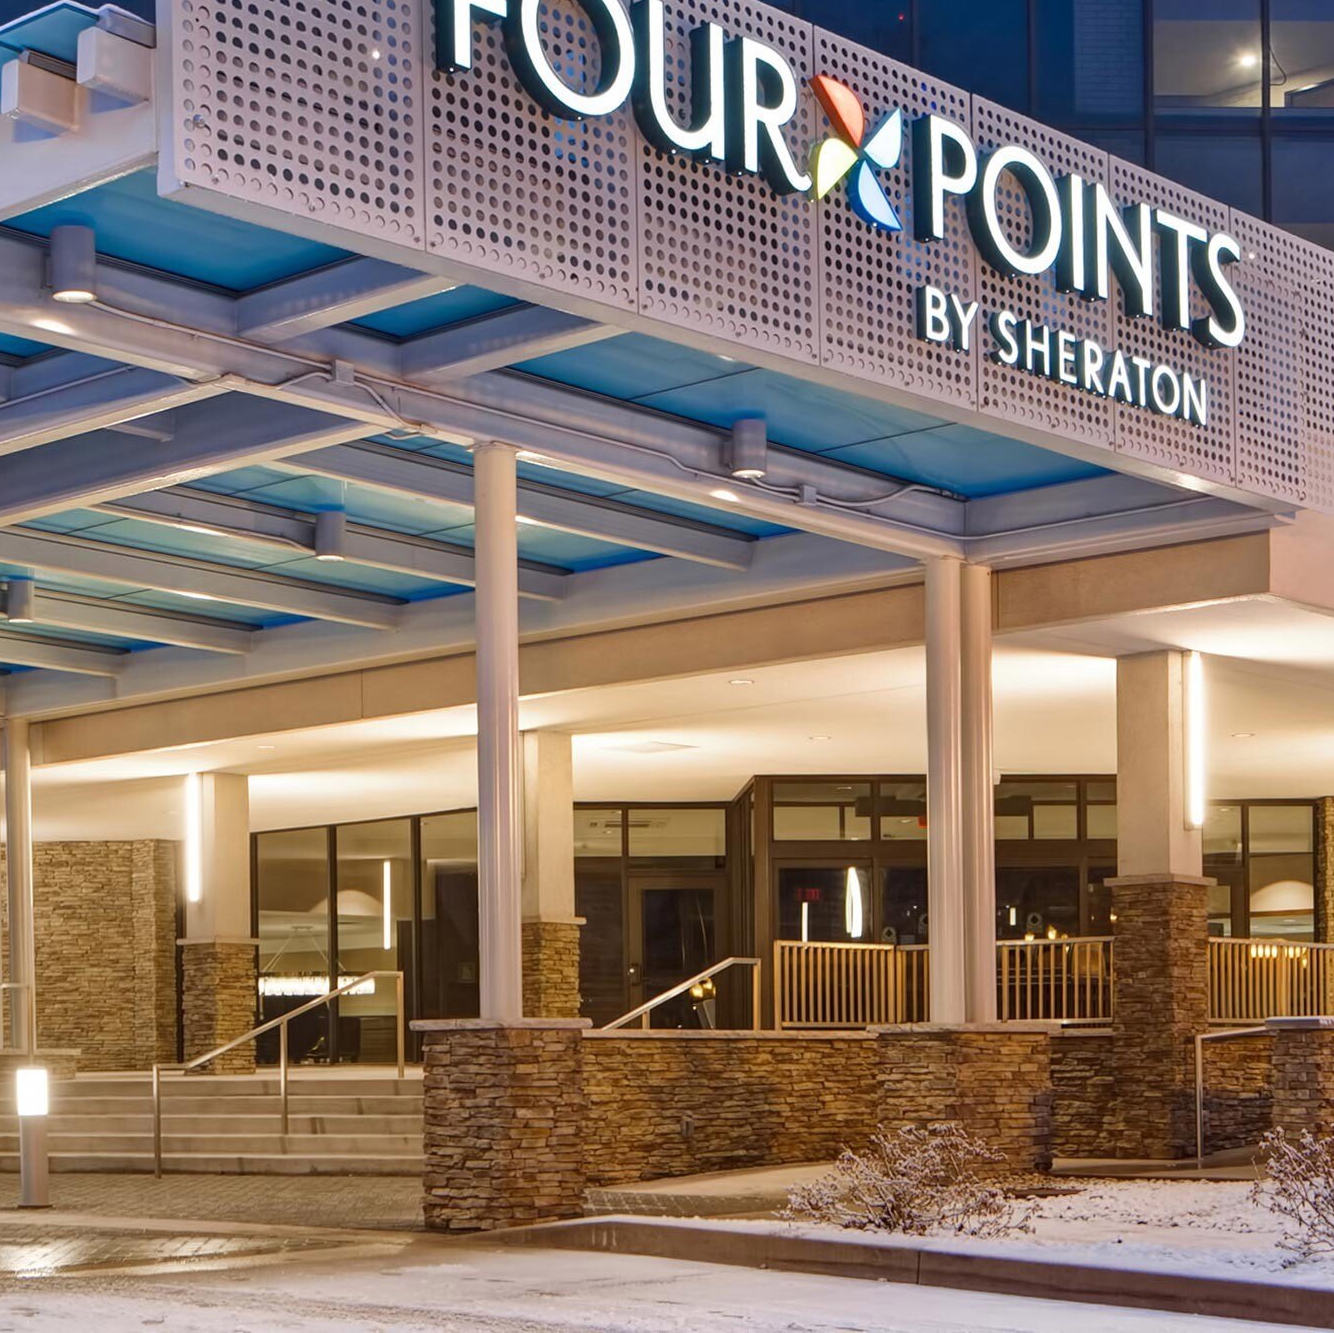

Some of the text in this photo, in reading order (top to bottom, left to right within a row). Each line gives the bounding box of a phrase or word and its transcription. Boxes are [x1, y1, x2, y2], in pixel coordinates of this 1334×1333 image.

[923, 113, 1246, 349] POINTS
[922, 284, 1208, 427] BY SHERATON
